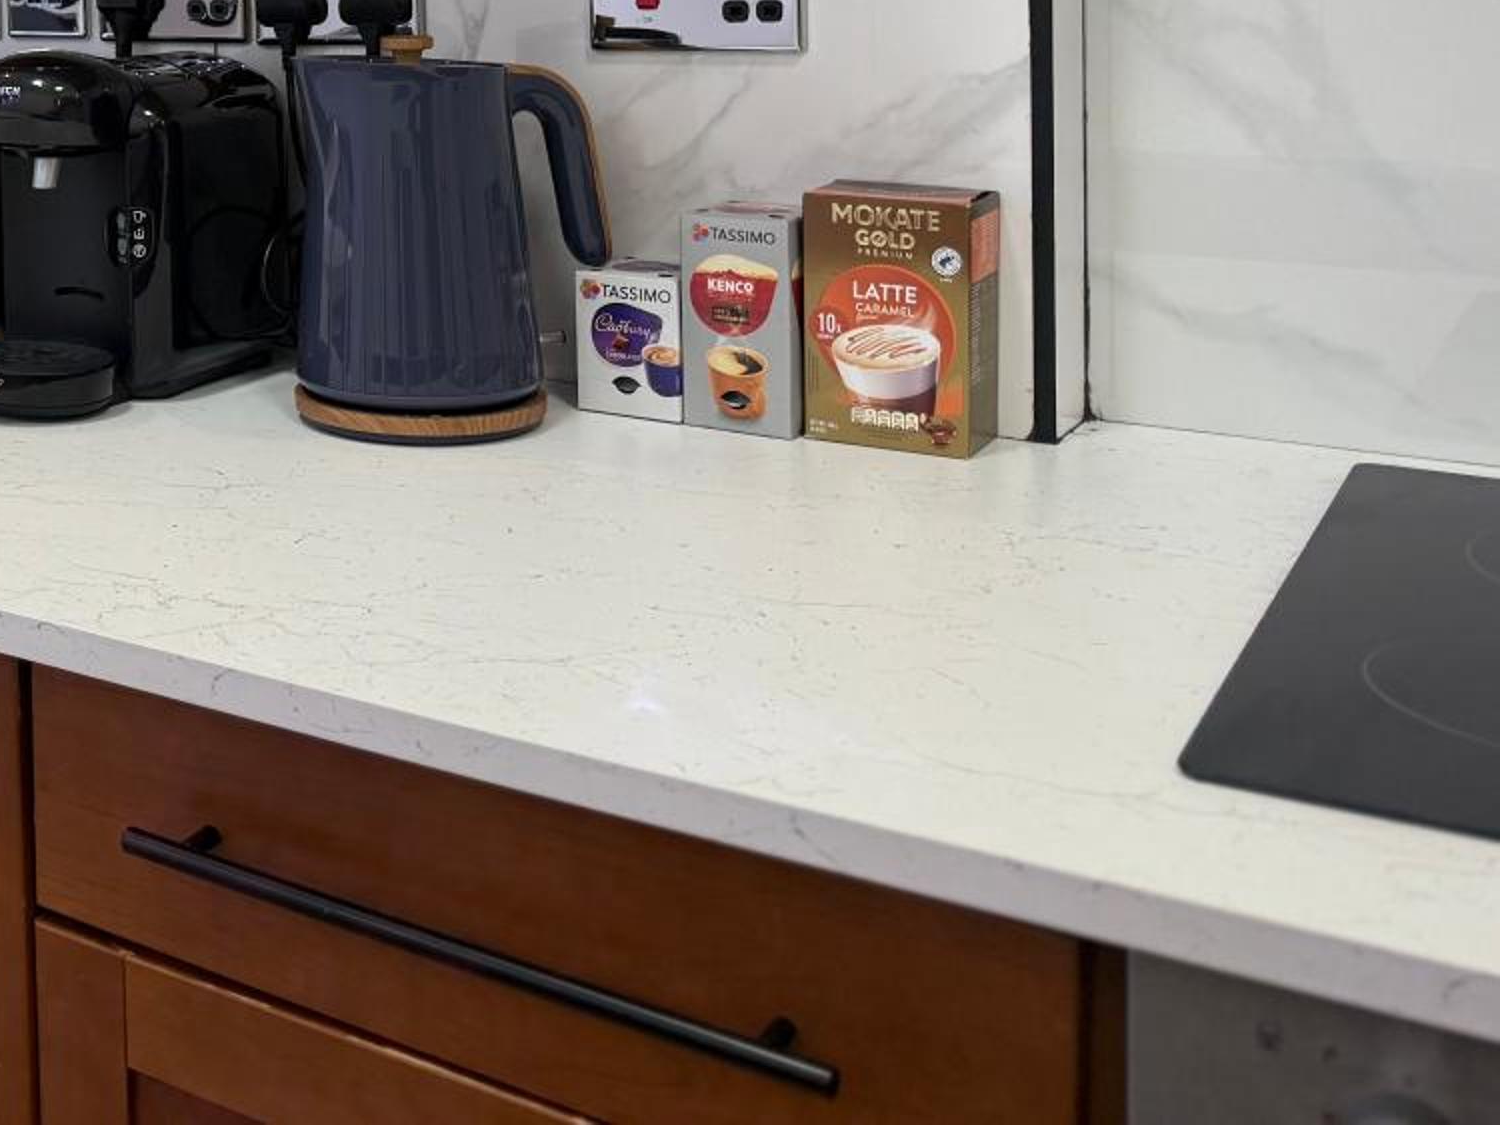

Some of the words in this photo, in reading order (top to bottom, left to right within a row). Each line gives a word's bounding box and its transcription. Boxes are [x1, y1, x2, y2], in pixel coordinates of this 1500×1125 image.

[831, 203, 940, 232] MOKATE
[711, 227, 775, 245] TASSIMO
[856, 229, 915, 250] GOLD
[857, 248, 913, 259] PREMIUM
[603, 284, 671, 303] TASSIMO
[707, 278, 754, 294] KENCO
[853, 280, 917, 303] LATTE
[855, 302, 915, 317] CARAMEL
[595, 314, 651, 339] Cadbury
